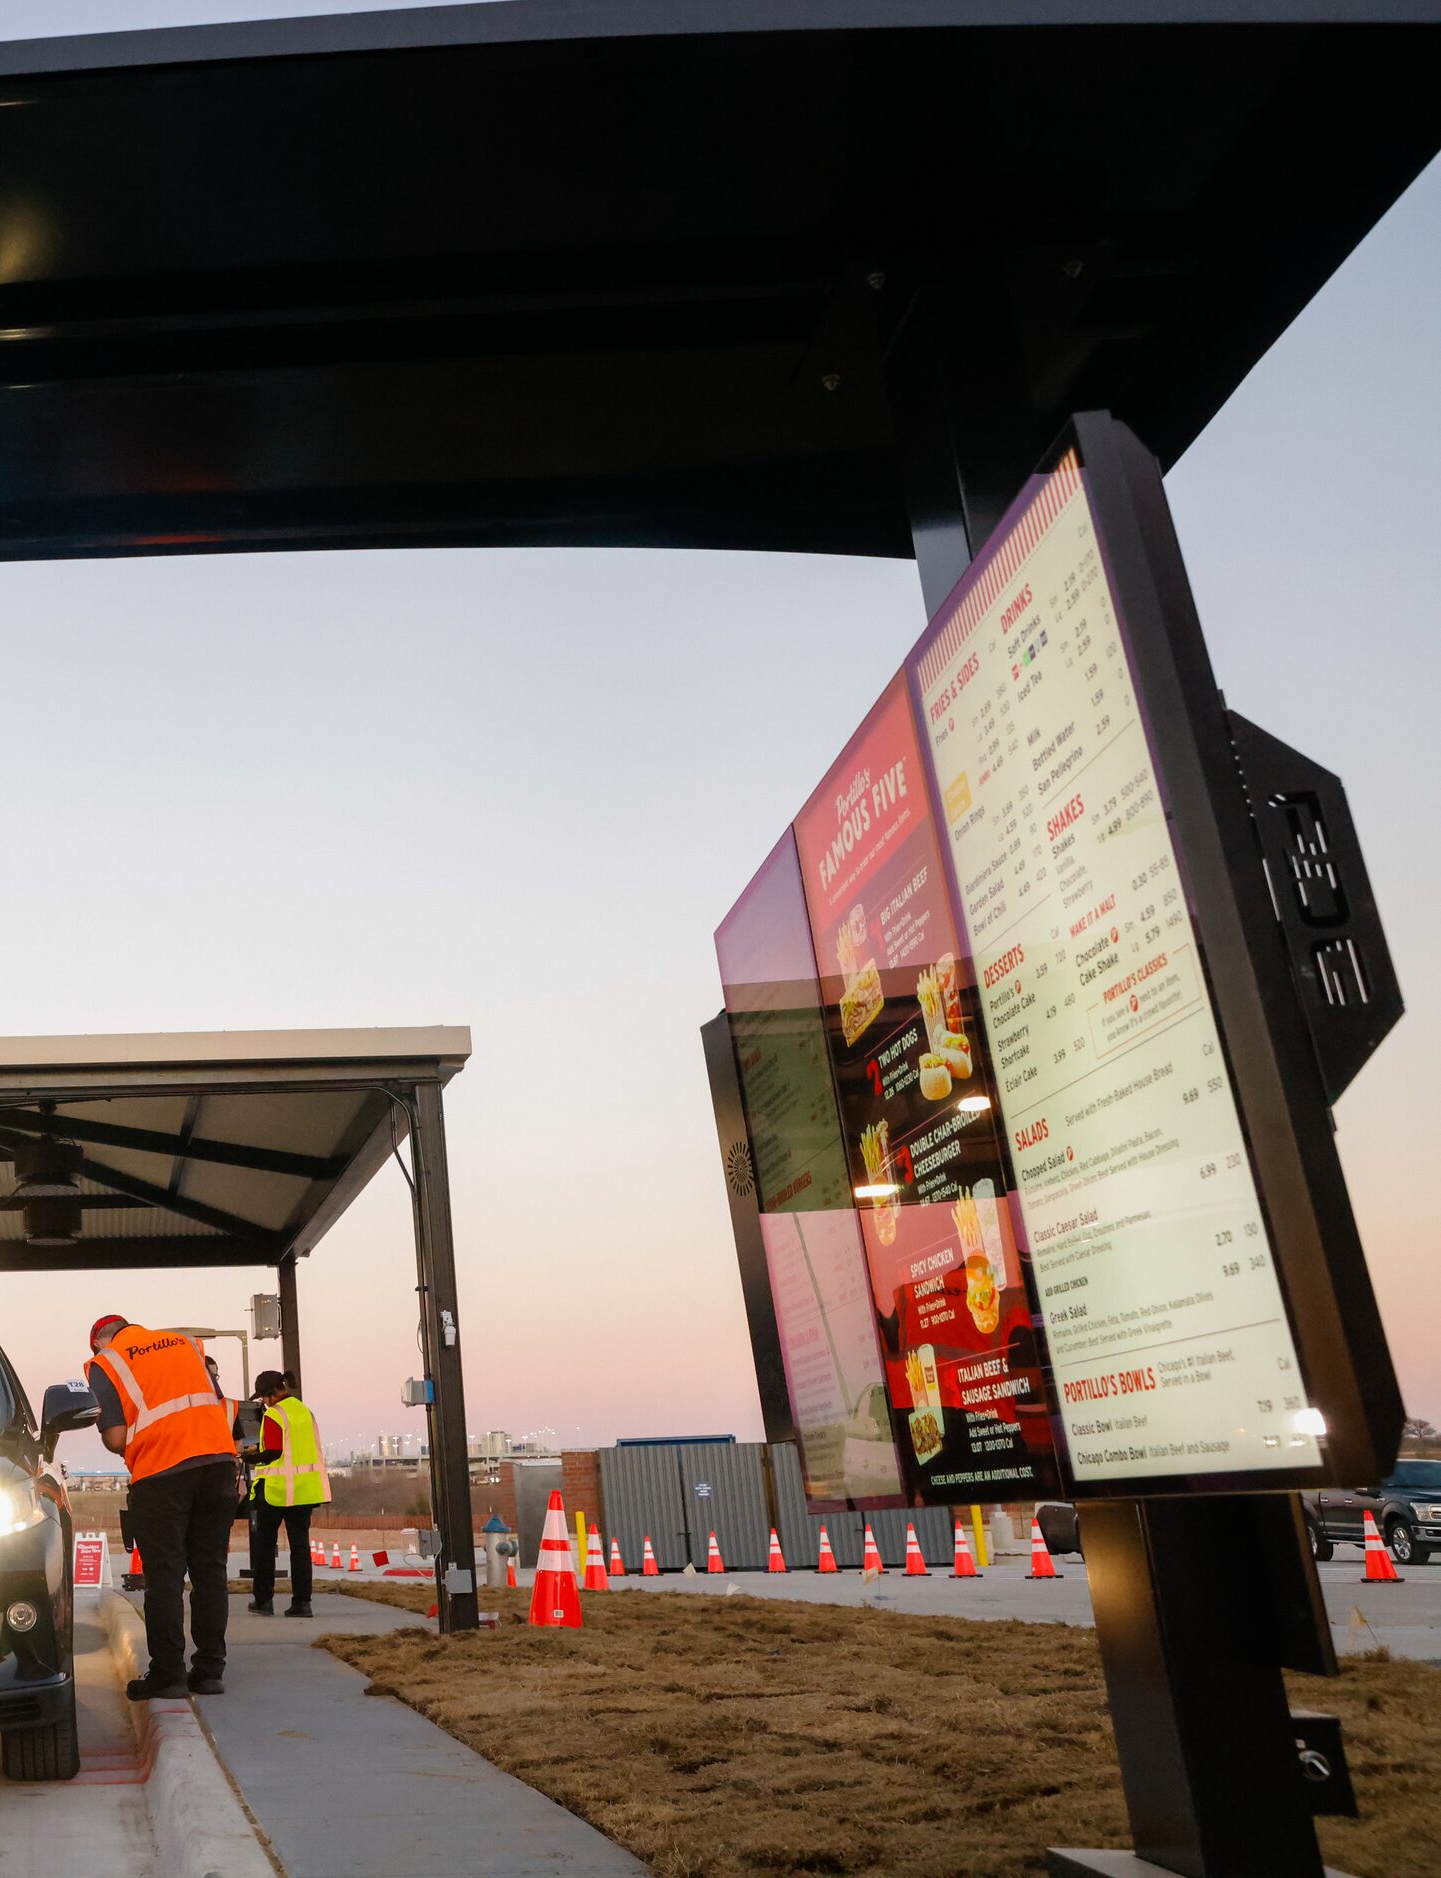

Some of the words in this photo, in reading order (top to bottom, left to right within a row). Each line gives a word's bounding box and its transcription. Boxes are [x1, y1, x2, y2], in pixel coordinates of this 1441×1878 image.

[1000, 582, 1033, 636] DRINKS
[1007, 637, 1021, 659] Soft
[1020, 614, 1041, 643] Drinks
[930, 688, 951, 725] FRIES
[950, 680, 958, 700] &
[957, 652, 979, 691] SIDES
[1030, 671, 1043, 687] Tea
[1027, 727, 1041, 747] Milk
[1032, 739, 1056, 772] Bottled
[1055, 721, 1075, 747] Water
[1038, 778, 1051, 796] San
[1050, 745, 1083, 783] Pellegrino
[836, 767, 871, 824] Portillo's
[818, 798, 871, 892] FAMOUS
[872, 761, 908, 818] FIVE
[1047, 793, 1085, 842] SHAKES
[991, 852, 1007, 871] Sauce
[1052, 833, 1075, 860] Shakes
[880, 906, 891, 926] BIG
[890, 882, 913, 915] ITALIAN
[912, 865, 928, 893] BEEF
[969, 894, 988, 916] Garden
[988, 878, 1005, 899] Salad
[1063, 879, 1094, 909] Strawberry
[973, 917, 988, 937] Bowl
[993, 900, 1007, 919] Chili
[1069, 916, 1087, 938] MAKE
[1087, 911, 1094, 927] IT
[1094, 906, 1100, 920] A
[1099, 893, 1116, 917] MALT
[983, 943, 1025, 990] DESSERTS
[1075, 937, 1110, 968] Chocolate
[1079, 968, 1097, 987] Cake
[1096, 952, 1119, 975] Shake
[1103, 972, 1137, 1004] PORTILLO'S
[1137, 952, 1168, 982] CLASSICS
[989, 987, 1015, 1013] Portillo's
[993, 1003, 1021, 1029] Chocolate
[1020, 993, 1036, 1010] Cake
[878, 1050, 891, 1069] TWO
[890, 1040, 902, 1060] HOT
[901, 1027, 918, 1051] DOGS
[997, 1025, 1030, 1052] Strawberry
[1000, 1045, 1030, 1070] Shortcake
[866, 1058, 883, 1097] 2
[1023, 1066, 1038, 1082] Cake
[1015, 1118, 1049, 1152] SALADS
[1065, 1110, 1085, 1127] Served
[1085, 1102, 1097, 1116] with
[1096, 1084, 1133, 1112] Fresh-Baked
[1133, 1074, 1153, 1092] House
[1153, 1061, 1174, 1081] Bread
[910, 1132, 935, 1159] DOUBLE
[913, 1140, 962, 1179] CHEESEBURGER
[895, 1144, 914, 1185] 3
[1021, 1161, 1047, 1182] Chopped
[1047, 1150, 1066, 1170] Salad
[1034, 1226, 1056, 1243] Classic
[1056, 1217, 1078, 1235] Caesar
[1079, 1207, 1098, 1226] Salad
[910, 1258, 927, 1279] SPICY
[927, 1247, 954, 1272] CHICKEN
[914, 1274, 945, 1299] SANDWICH
[1044, 1287, 1053, 1297] ADD
[1053, 1281, 1070, 1295] GRILLED
[1069, 1276, 1088, 1290] CHICKEN
[1049, 1309, 1068, 1325] Greek
[1069, 1301, 1088, 1320] Salad
[126, 1337, 186, 1360] Portillo's
[957, 1363, 984, 1384] ITALIAN
[983, 1358, 1001, 1377] BEEF
[1001, 1357, 1009, 1374] &
[1063, 1374, 1118, 1403] PORTILLO'S
[1118, 1367, 1156, 1395] BOWLS
[1160, 1375, 1183, 1388] Served
[961, 1385, 993, 1406] SAUSAGE
[992, 1376, 1031, 1400] SANDWICH
[969, 1427, 978, 1438] Add
[976, 1425, 990, 1437] Sweet
[994, 1423, 1003, 1434] Hot
[1002, 1422, 1022, 1434] Peppers
[1071, 1421, 1095, 1436] Classic
[1096, 1418, 1112, 1434] Bowl
[1115, 1417, 1133, 1430] Italian
[1133, 1414, 1148, 1428] Beef
[1005, 1437, 1013, 1449] Cal
[1077, 1449, 1104, 1466] Chicago
[1104, 1448, 1128, 1463] Combo
[1129, 1445, 1148, 1461] Bowl
[1149, 1444, 1169, 1458] Italian
[1169, 1442, 1185, 1455] Beef
[1186, 1442, 1199, 1454] and
[1200, 1439, 1230, 1455] Sausage
[931, 1475, 947, 1486] CHEESE
[946, 1474, 955, 1484] AND
[954, 1472, 975, 1484] PEPPERS
[974, 1471, 984, 1482] ARE
[983, 1470, 991, 1480] AN
[991, 1468, 1020, 1480] ADDITIONAL
